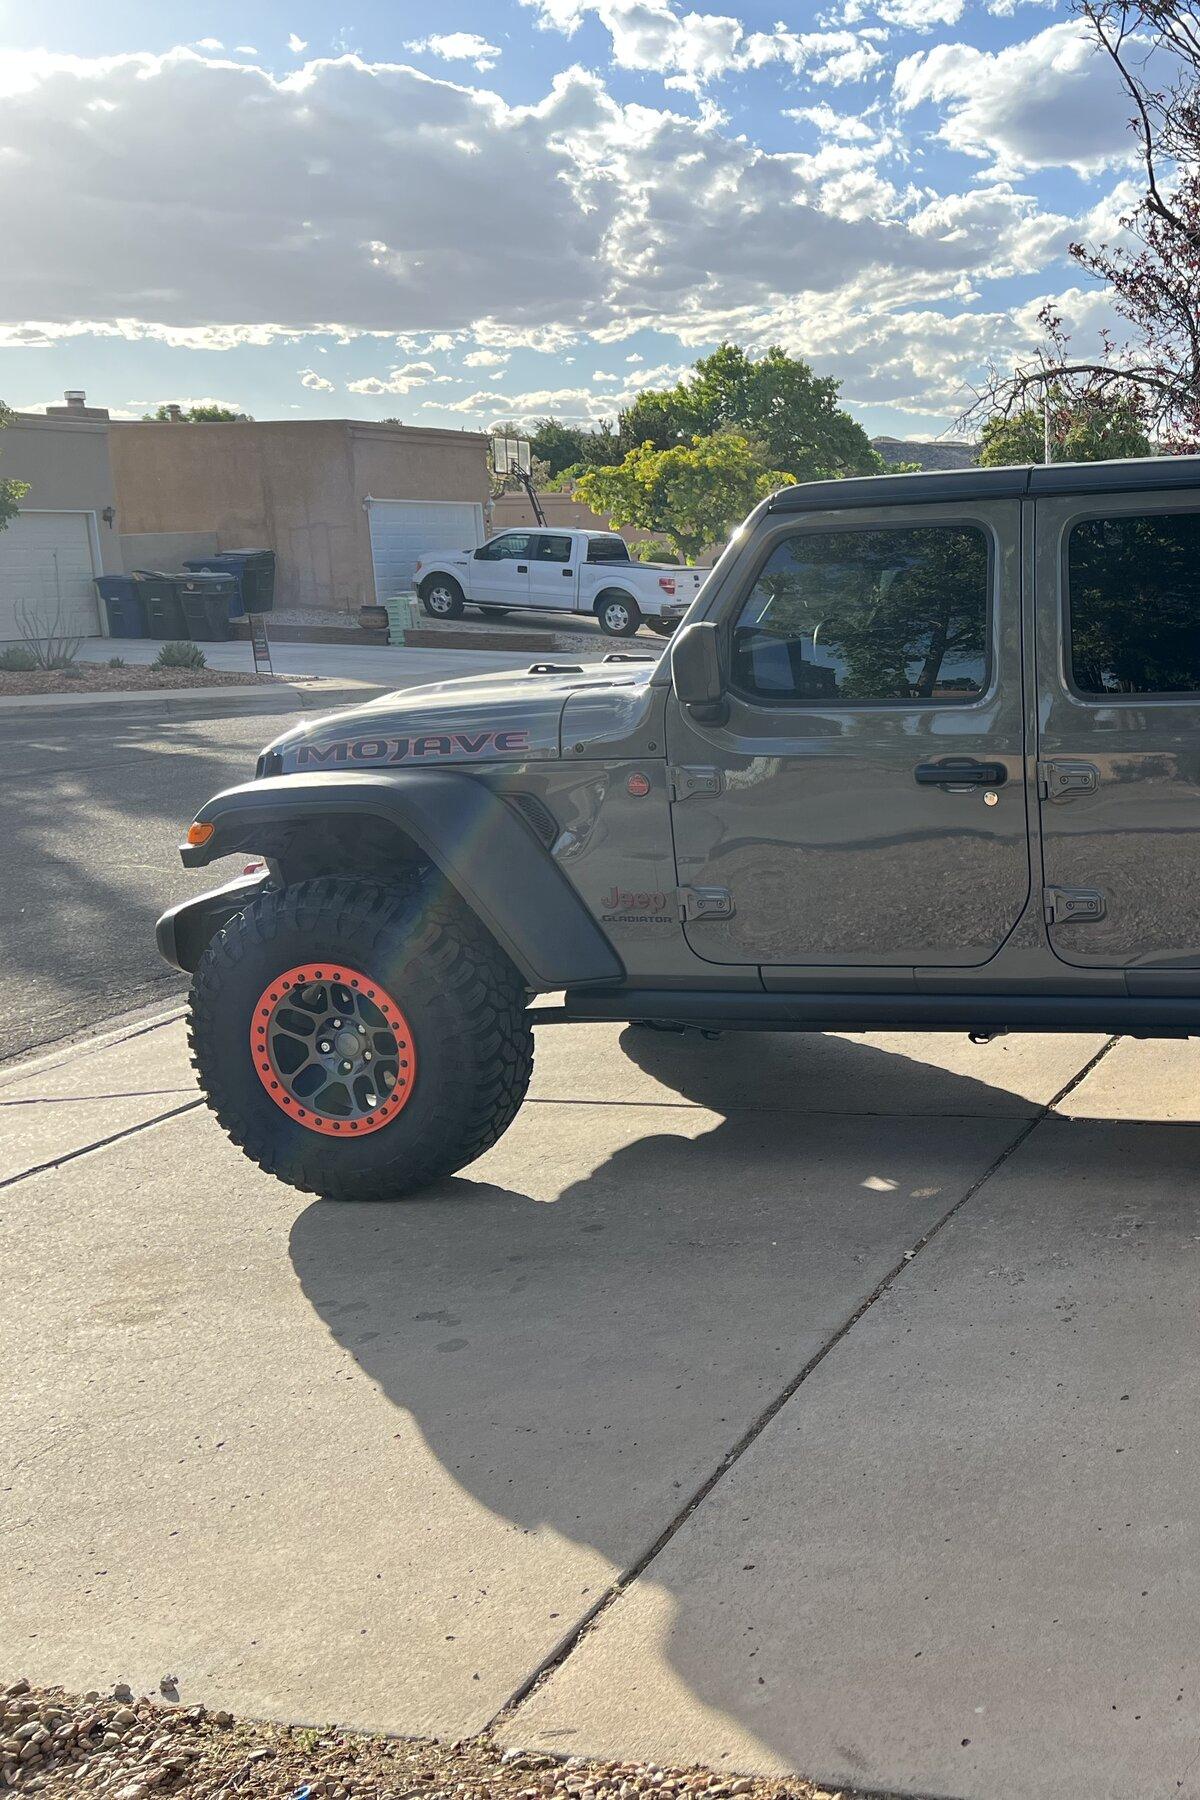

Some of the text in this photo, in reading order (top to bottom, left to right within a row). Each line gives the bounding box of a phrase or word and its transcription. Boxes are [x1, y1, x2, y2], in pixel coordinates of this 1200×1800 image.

[296, 730, 531, 764] MOJAVE
[600, 886, 667, 914] Jeep
[602, 914, 673, 924] GLADIATOR
